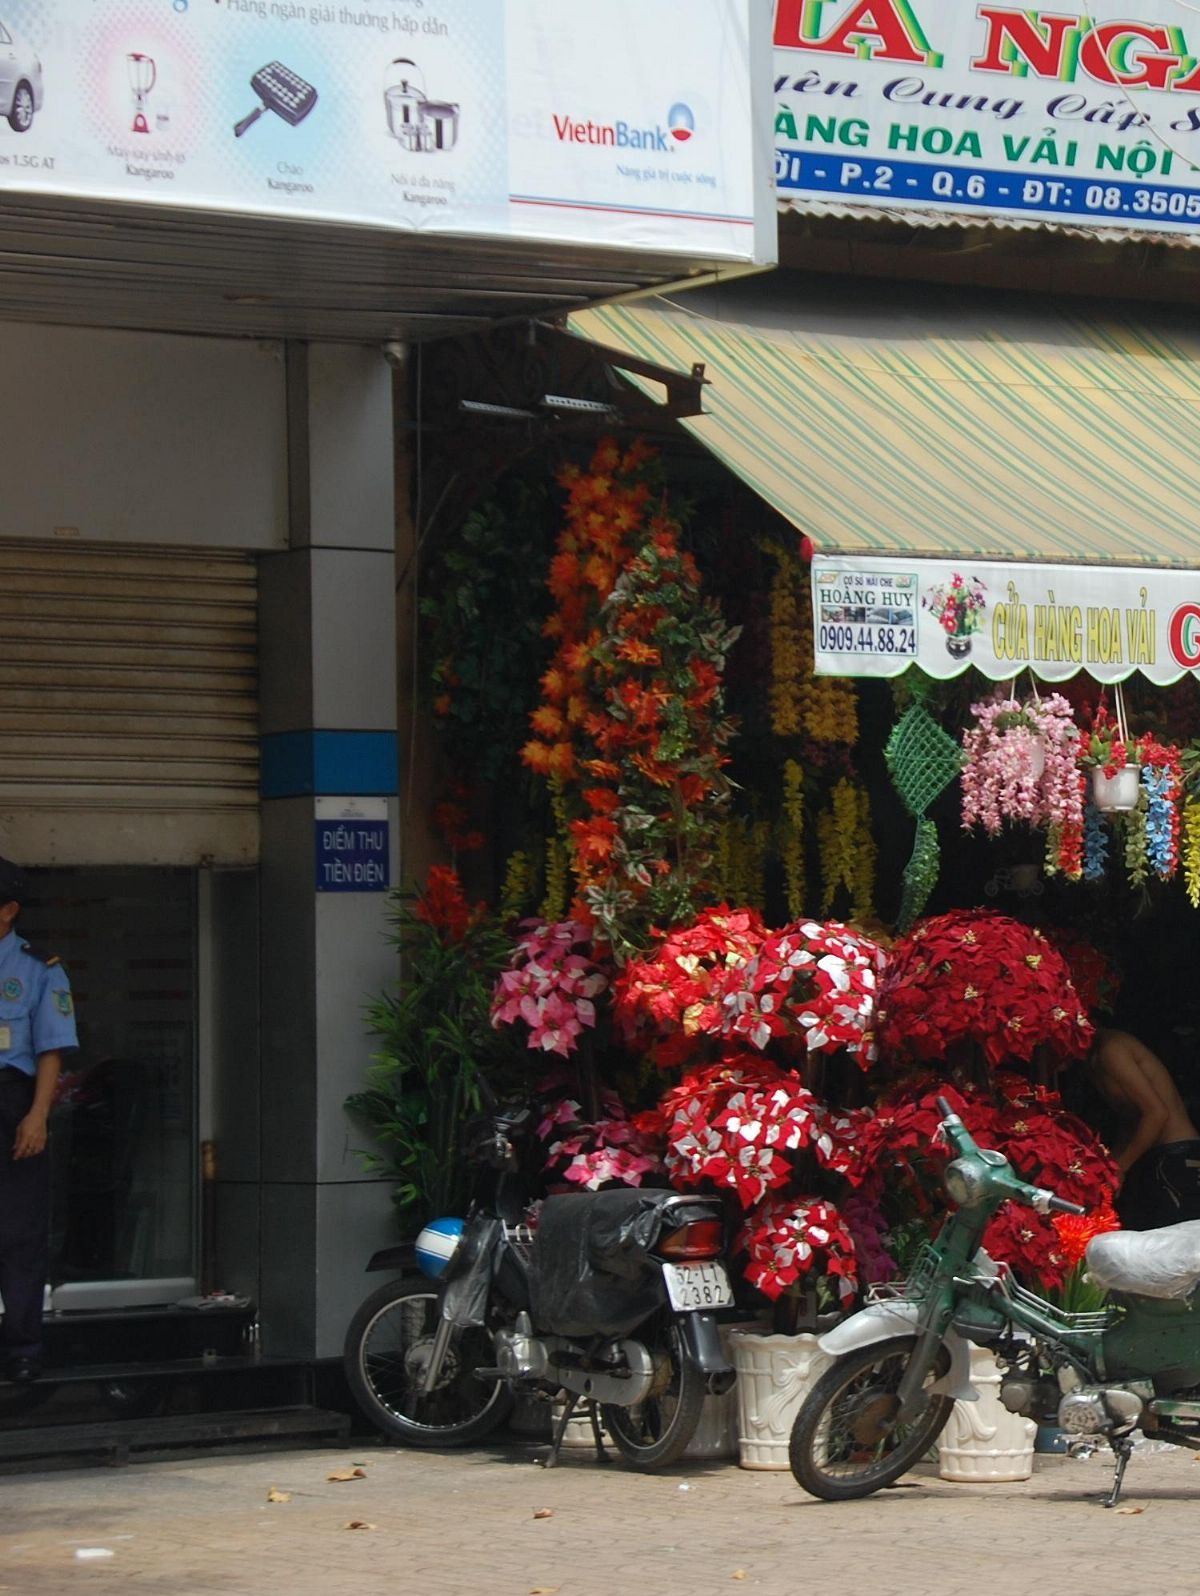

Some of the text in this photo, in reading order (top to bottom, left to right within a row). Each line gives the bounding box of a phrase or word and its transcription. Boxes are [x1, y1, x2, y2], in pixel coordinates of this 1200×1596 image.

[882, 76, 1027, 120] Cung
[1046, 94, 1151, 131] Cấp
[552, 114, 668, 152] VietinBank
[888, 122, 982, 159] HOA
[1002, 127, 1079, 167] VẢI
[1095, 140, 1176, 179] NỘI
[840, 161, 894, 191] P.2
[932, 171, 987, 199] Q.6
[1022, 179, 1073, 207] ĐT:
[820, 586, 914, 607] HOÀNG HUY
[819, 624, 916, 653] 0909.44.88.24
[992, 580, 1157, 665] CỬA HÀNG HOA VẢI
[323, 824, 384, 850] ĐIỂM THU
[323, 857, 385, 888] TIỀN ĐIỆN
[680, 1284, 725, 1306] 2382
